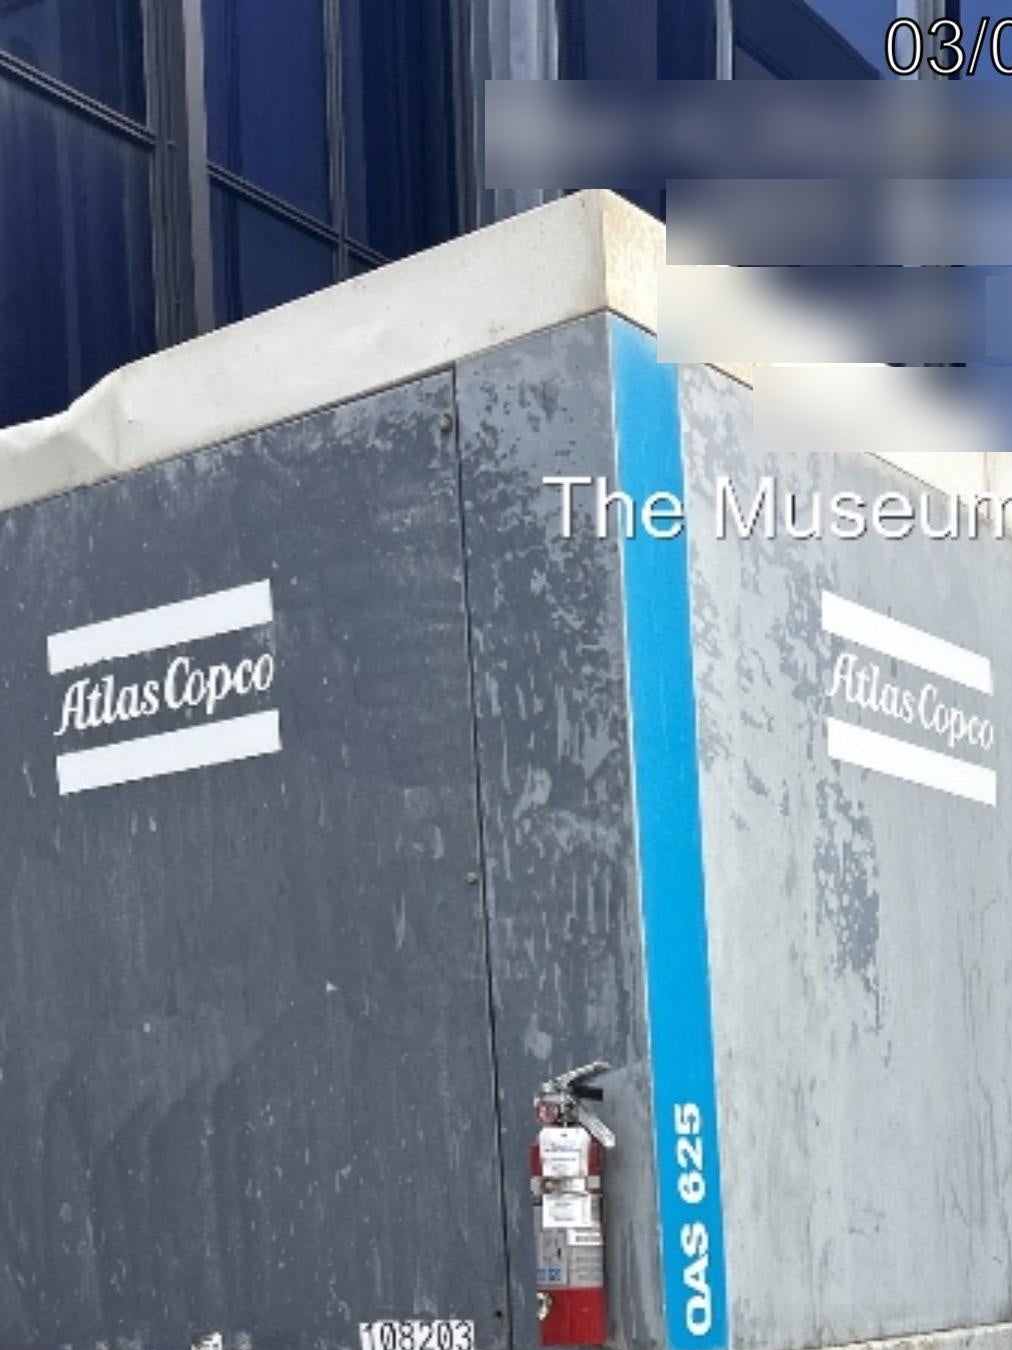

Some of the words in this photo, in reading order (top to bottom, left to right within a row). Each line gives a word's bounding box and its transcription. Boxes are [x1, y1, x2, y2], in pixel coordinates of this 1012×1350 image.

[53, 674, 160, 736] Atlas
[164, 653, 274, 716] Copco
[826, 652, 916, 724] Atlas
[918, 683, 994, 750] Copco
[673, 1102, 706, 1205] 625
[680, 1221, 713, 1337] QAS
